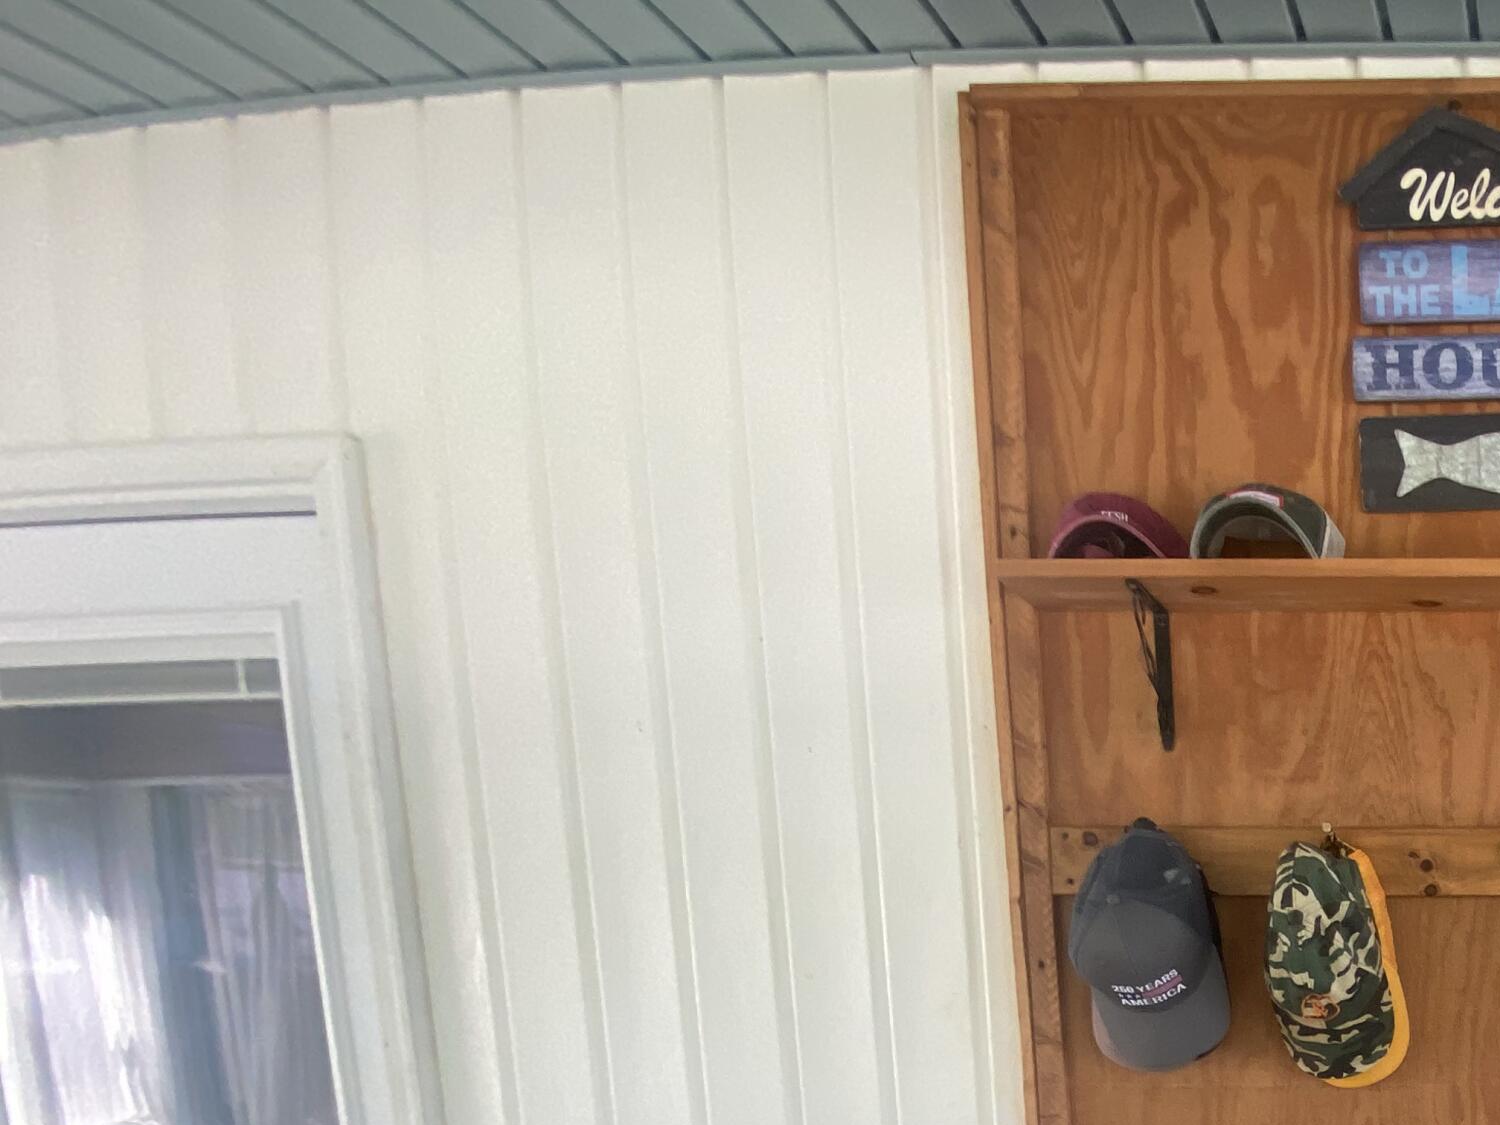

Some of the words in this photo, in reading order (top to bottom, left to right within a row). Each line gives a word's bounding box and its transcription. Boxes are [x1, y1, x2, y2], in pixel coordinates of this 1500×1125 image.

[1379, 250, 1429, 279] TO
[1369, 284, 1442, 317] THE
[1135, 969, 1178, 992] YEARS
[1121, 983, 1187, 1006] AMERICA
